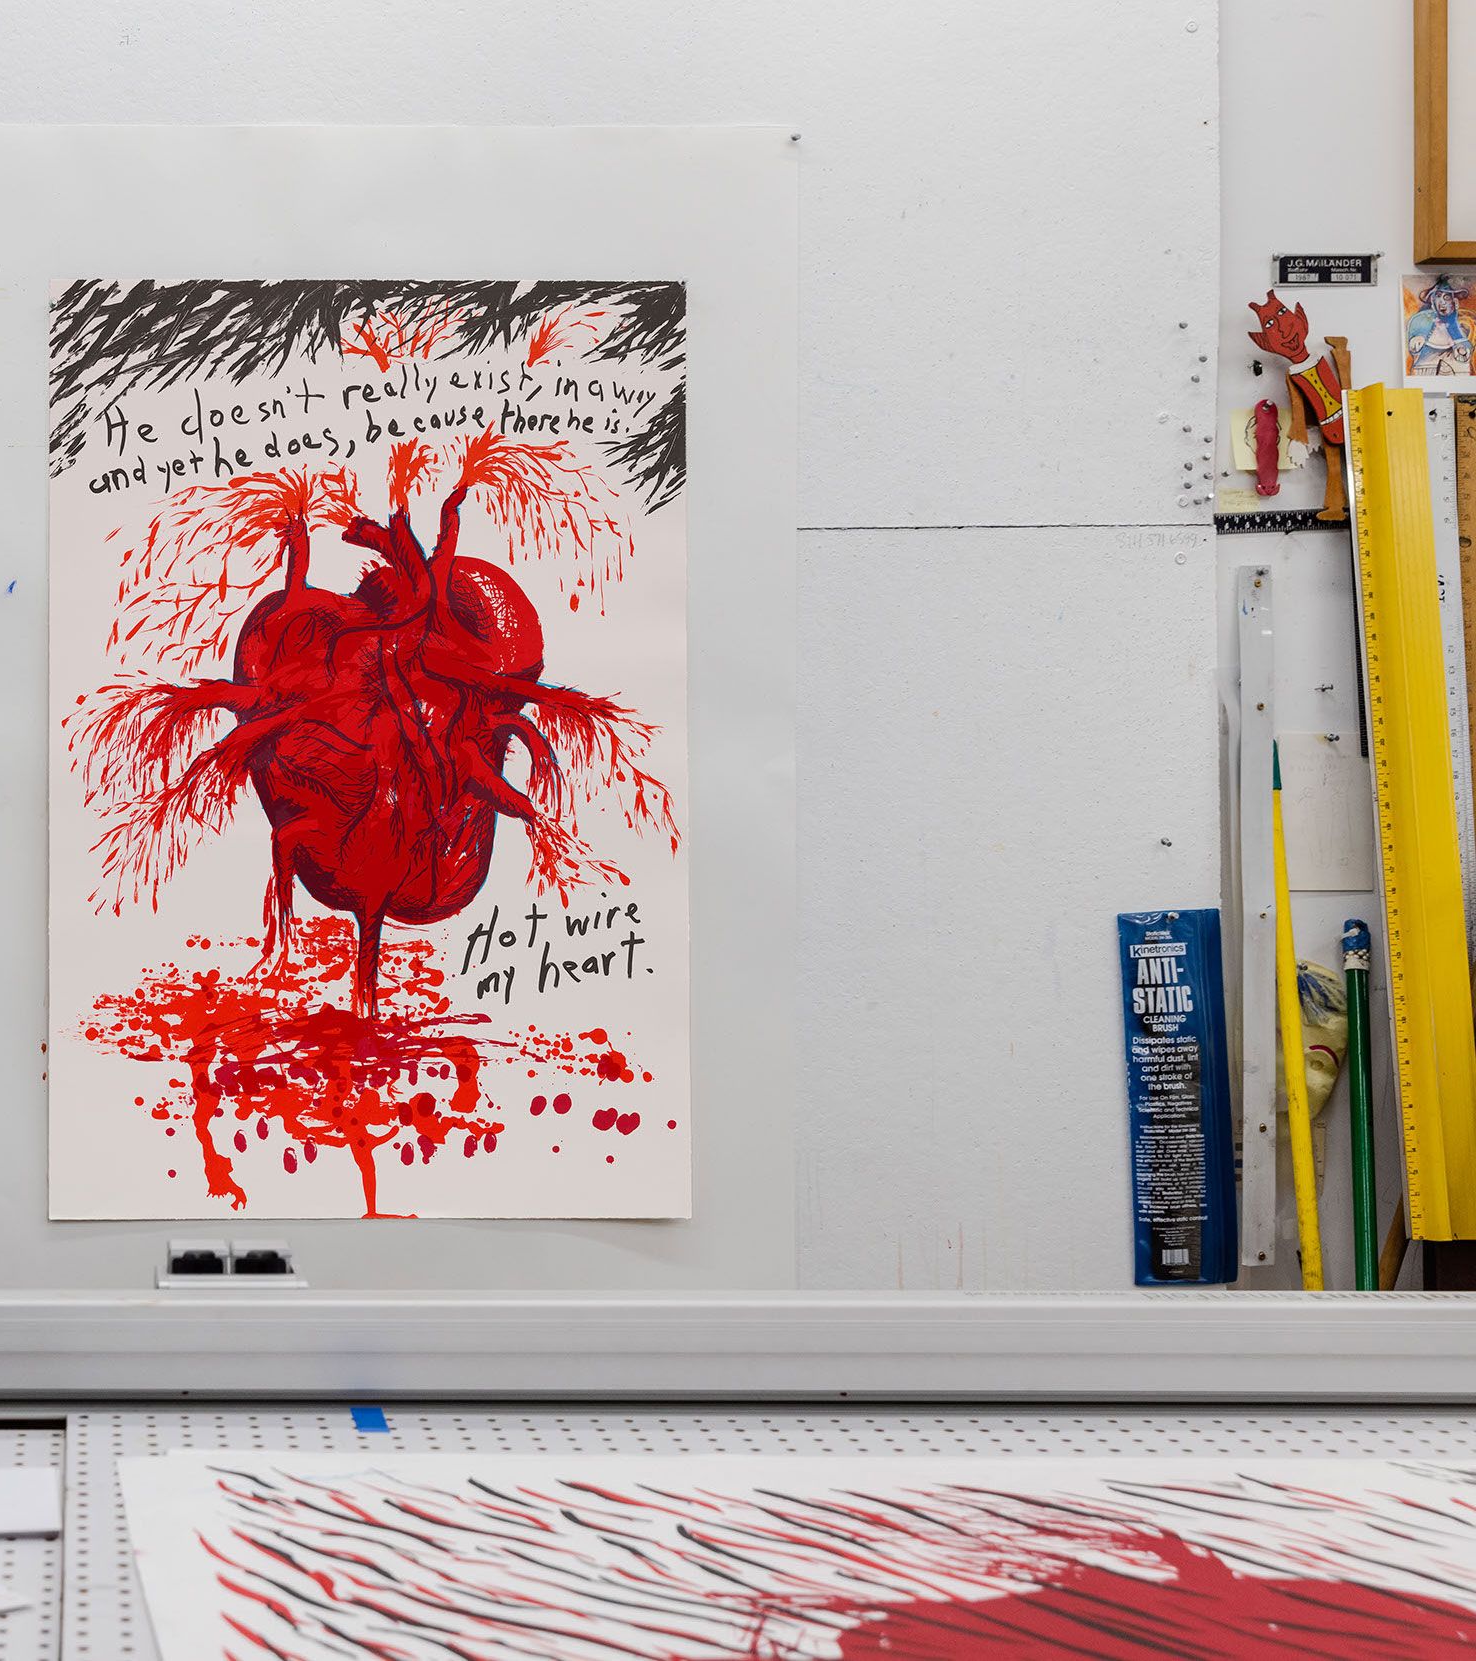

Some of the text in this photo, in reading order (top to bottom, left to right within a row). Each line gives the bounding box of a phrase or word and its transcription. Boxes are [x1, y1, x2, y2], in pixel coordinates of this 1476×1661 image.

[105, 359, 656, 456] He doesn't really exist, in a way
[89, 456, 147, 494] and
[157, 450, 204, 494] yet
[213, 437, 253, 478] he
[264, 428, 357, 458] does,
[366, 405, 485, 443] because
[566, 409, 594, 434] he
[604, 409, 630, 434] is.
[460, 892, 641, 975] Hot wire
[477, 931, 654, 1005] my heart.
[1137, 957, 1184, 984] ANTI-
[1132, 986, 1194, 1014] STATIC
[1143, 1015, 1186, 1024] CLEANING
[1152, 1024, 1179, 1032] BRUSH
[1132, 1035, 1196, 1045] Dissipates static
[1132, 1046, 1150, 1054] and
[1151, 1046, 1176, 1054] wipes
[1188, 1054, 1198, 1062] lint
[1163, 1082, 1187, 1090] brush.
